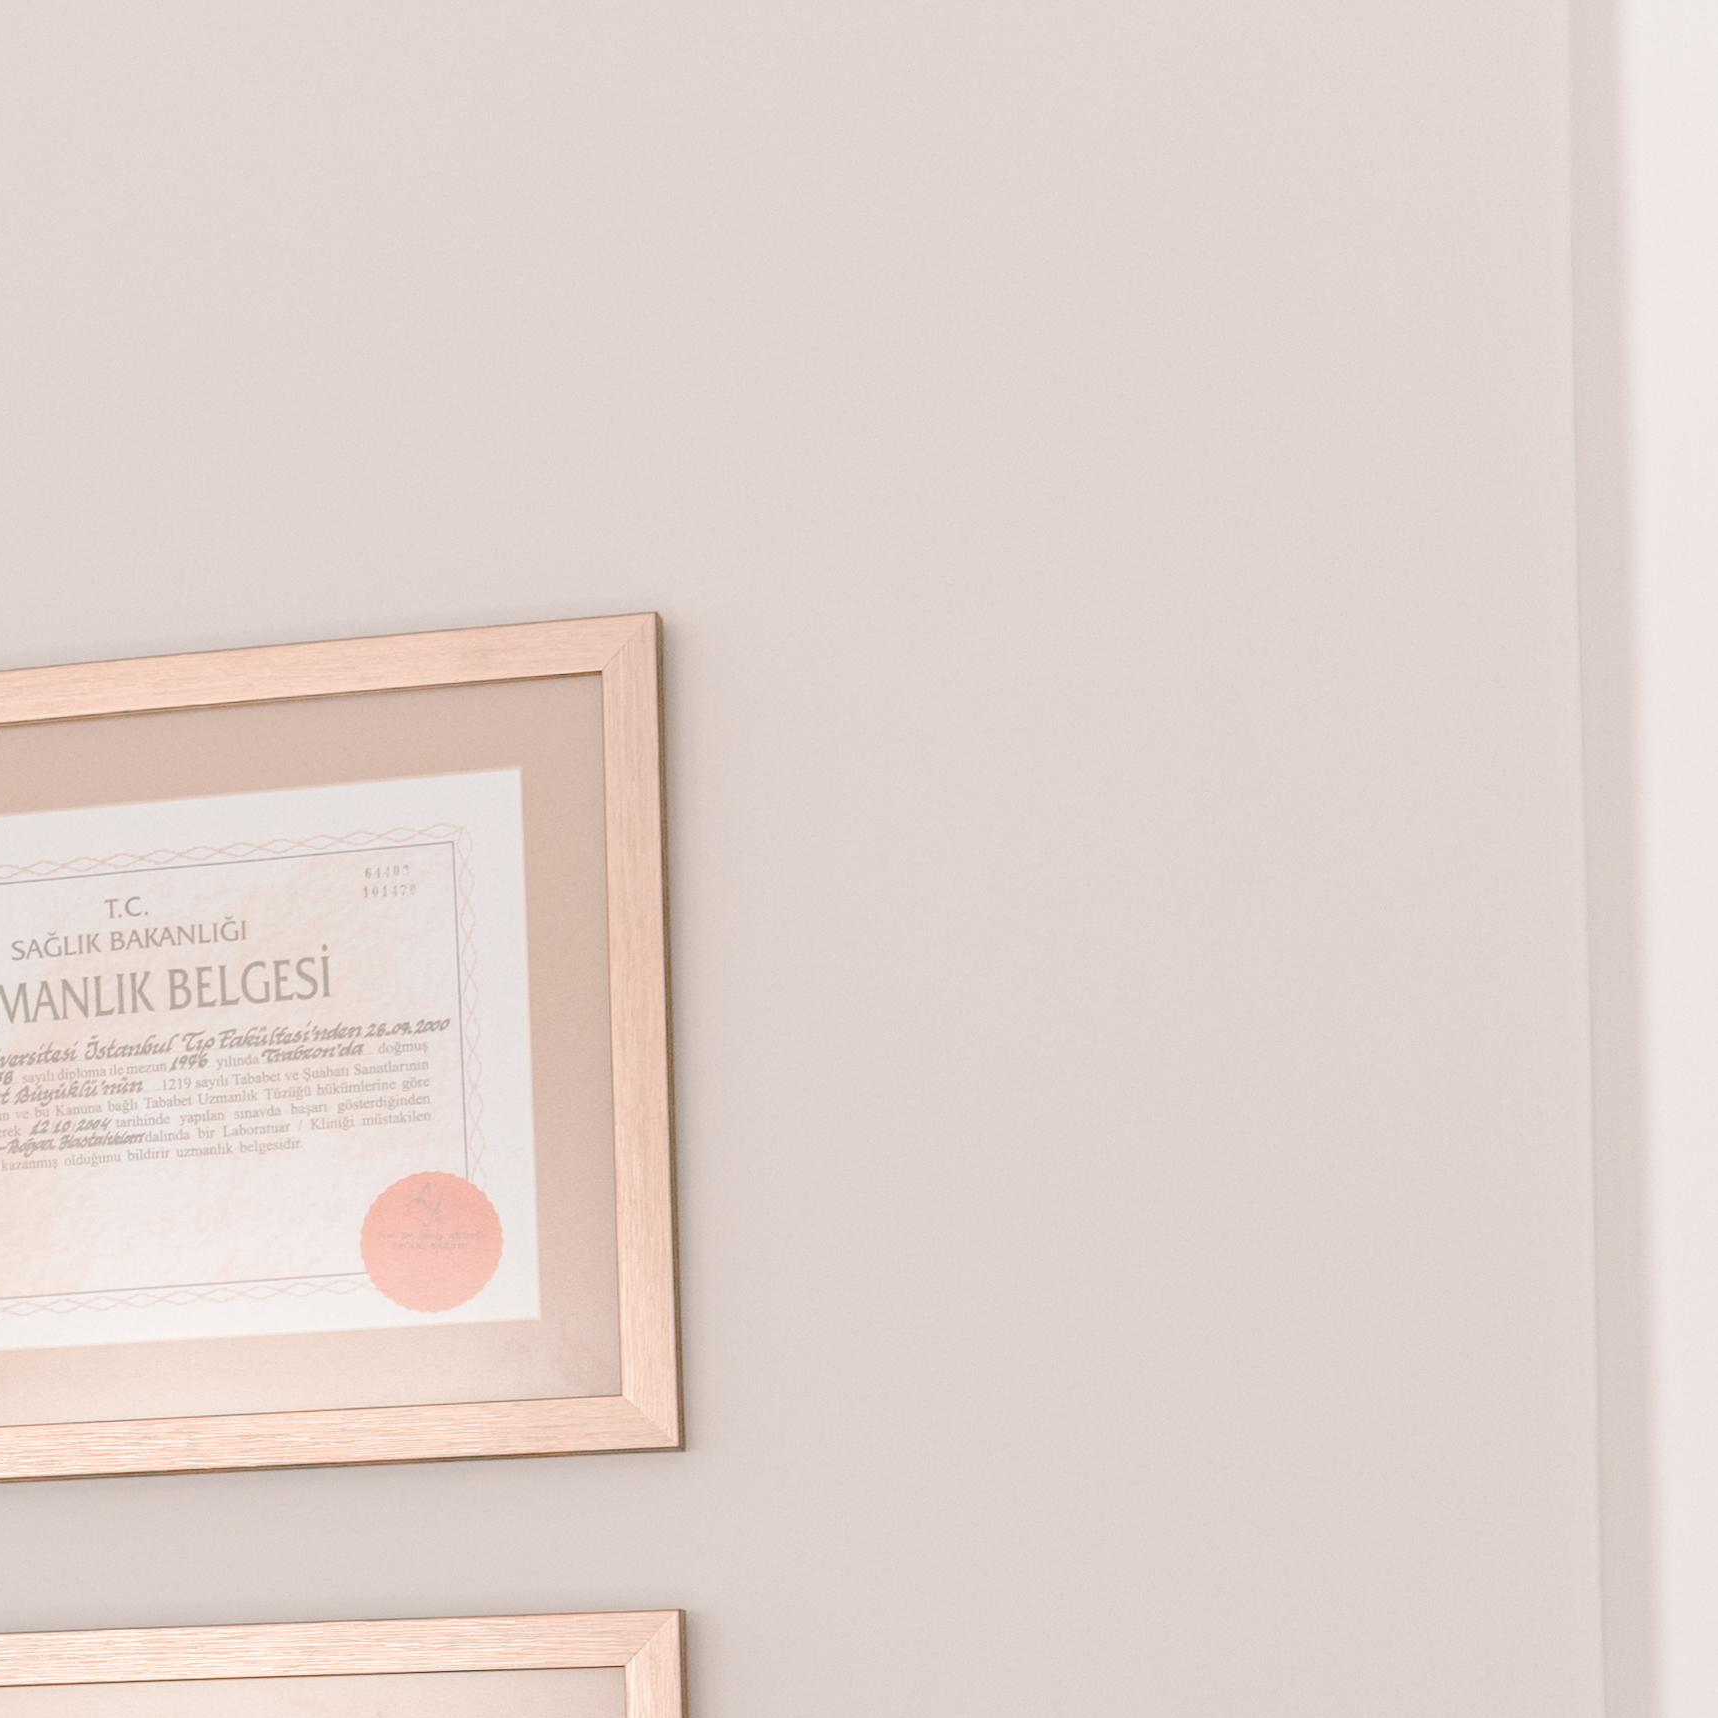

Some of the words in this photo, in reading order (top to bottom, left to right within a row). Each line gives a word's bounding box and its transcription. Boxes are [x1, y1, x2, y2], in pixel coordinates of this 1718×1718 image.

[105, 896, 149, 919] T.C.
[11, 931, 102, 961] SAĞLIK
[110, 916, 247, 952] BAKANLIĞI
[168, 944, 331, 1010] BELGESİ
[22, 1070, 55, 1083] sayılı
[57, 1067, 106, 1080] diploma
[109, 1064, 124, 1076] ile
[127, 1063, 167, 1074] mezun
[216, 1053, 260, 1071] yılında
[377, 1041, 428, 1056] doğmuş
[84, 1033, 180, 1061] İstanbul
[163, 1077, 192, 1090] 1219
[195, 1074, 229, 1091] sayılı
[232, 1071, 281, 1085] Tababet
[285, 1072, 299, 1080] ve
[303, 1066, 349, 1082] Şuabatı
[353, 1060, 429, 1076] Sanatlarının
[0, 1158, 58, 1171] kazanmış
[63, 1153, 121, 1167] olduğunu
[127, 1147, 171, 1161] bildirir
[176, 1141, 234, 1157] uzmanlık
[239, 1137, 303, 1155] belgesidir.
